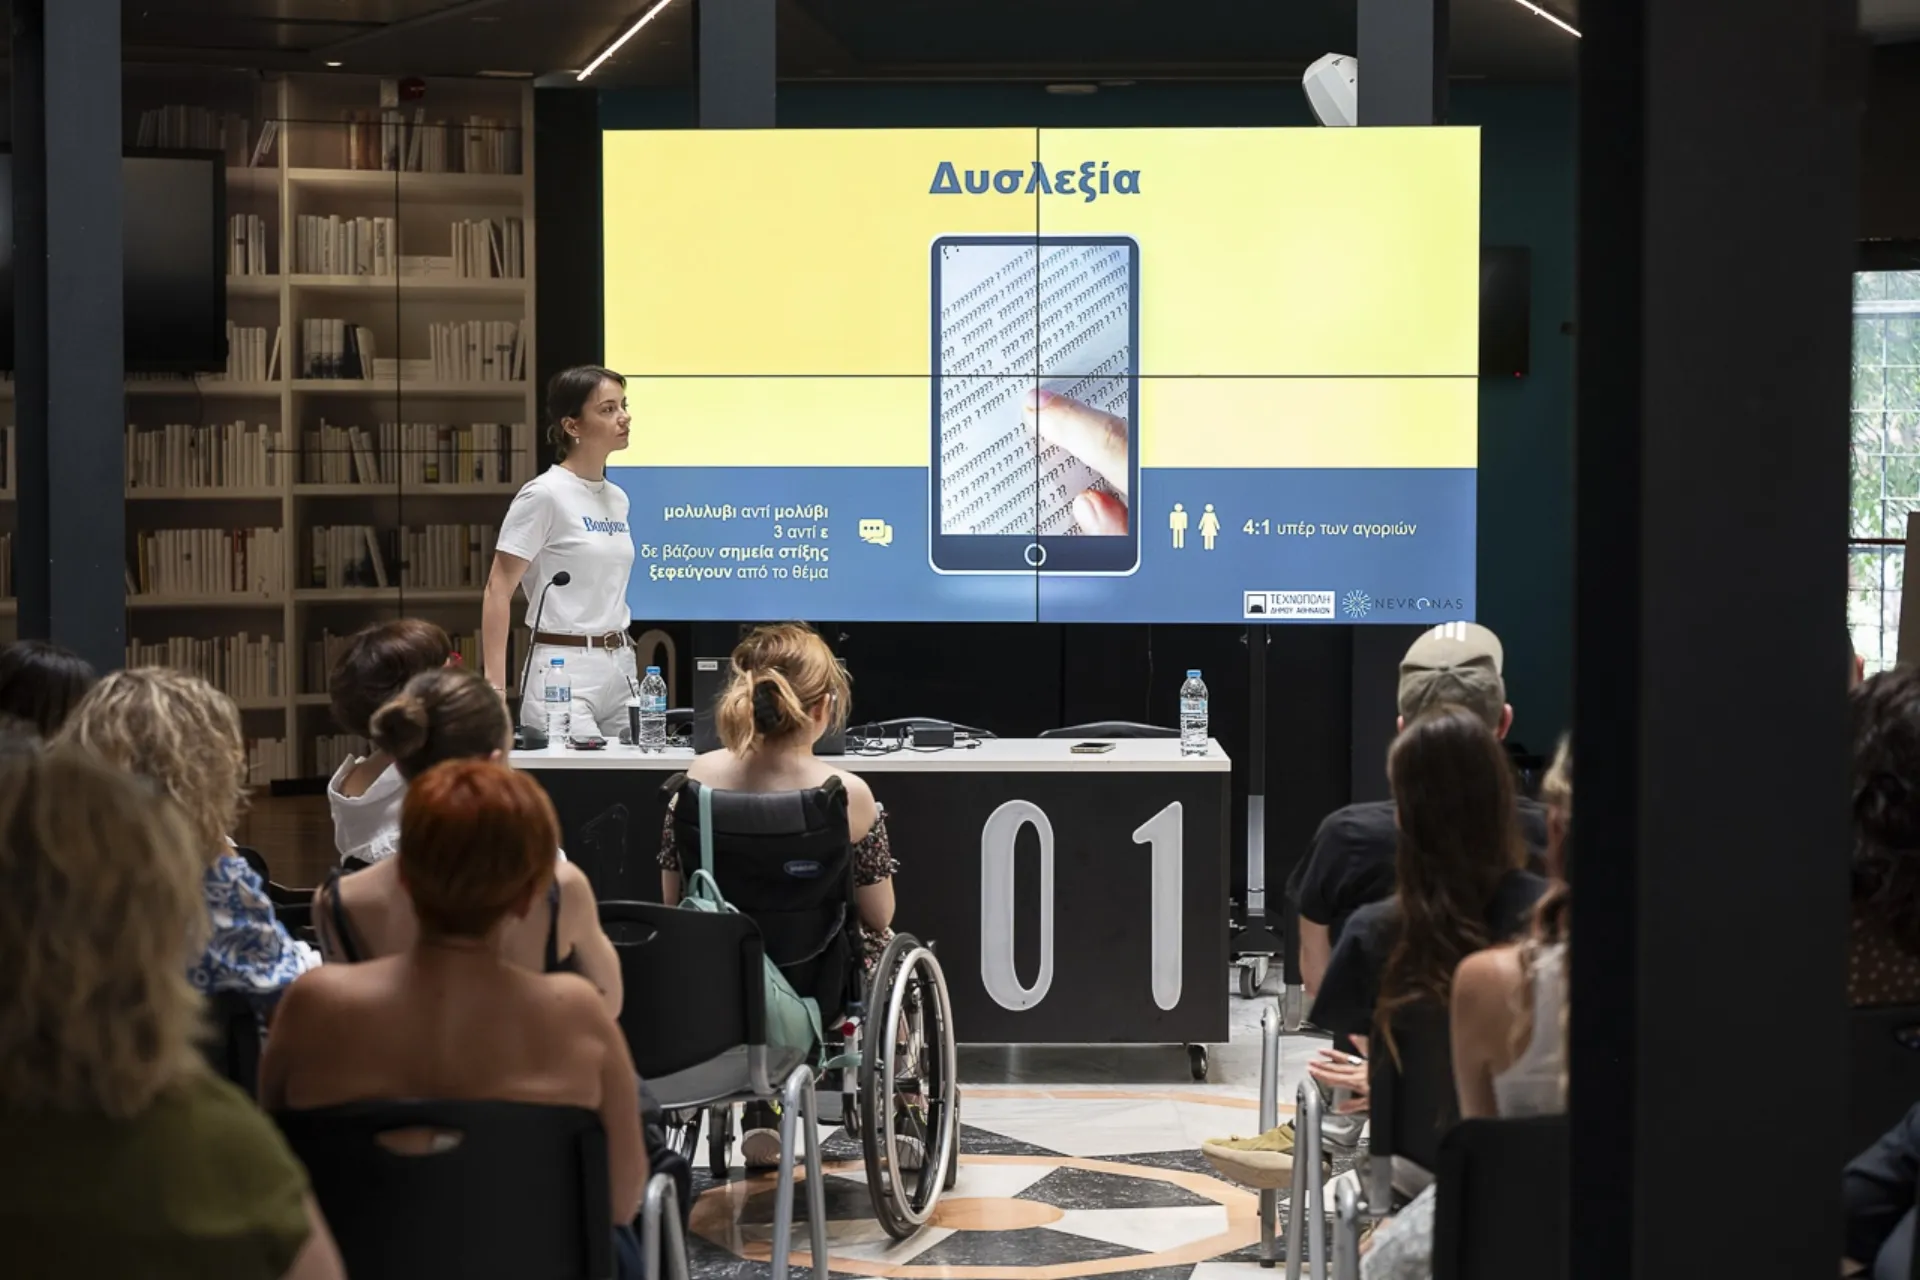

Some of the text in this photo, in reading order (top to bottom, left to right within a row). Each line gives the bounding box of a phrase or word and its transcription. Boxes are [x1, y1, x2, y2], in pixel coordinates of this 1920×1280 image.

[929, 161, 1141, 203] Δυσλεξία
[664, 504, 829, 521] μολυλυβι αντί μολύβι
[582, 515, 627, 537] Bonjou
[787, 525, 817, 539] αντί
[820, 527, 829, 539] ε
[1243, 519, 1417, 538] 4:1 υπέρ των αγοριών
[641, 544, 829, 561] δε βάζουν σημεία στίξης
[649, 565, 829, 582] ξεφεύγουν από το θέμα
